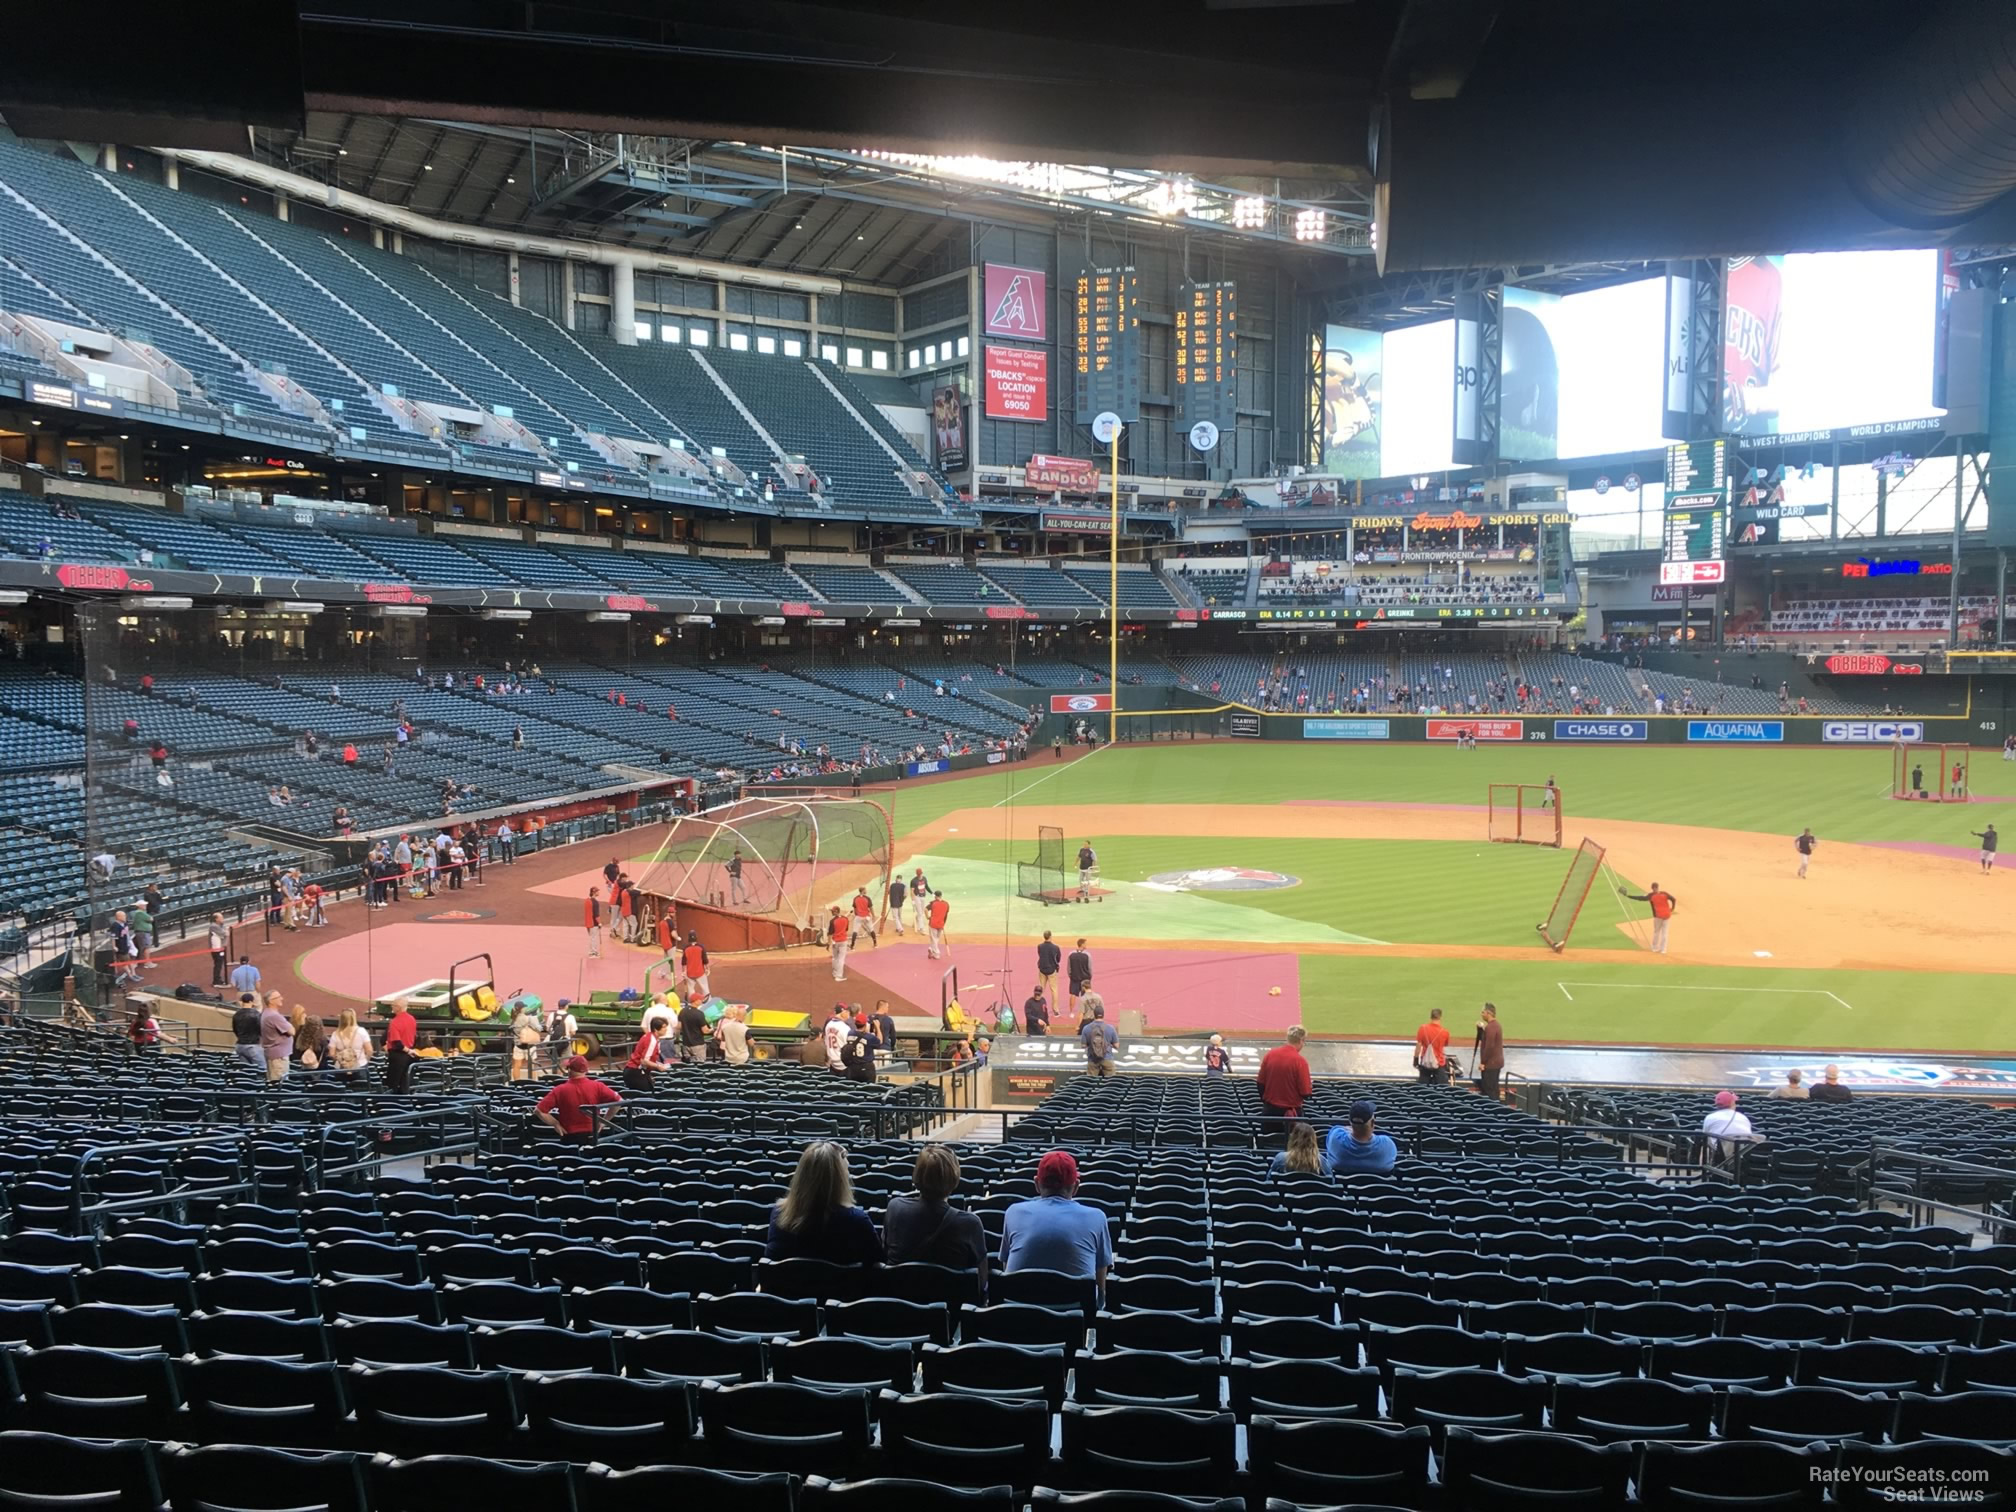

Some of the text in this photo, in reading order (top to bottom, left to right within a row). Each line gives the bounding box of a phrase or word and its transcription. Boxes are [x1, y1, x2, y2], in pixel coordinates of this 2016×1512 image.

[990, 348, 1007, 356] Report
[1024, 353, 1045, 361] Conduct
[1021, 360, 1039, 369] Texting
[998, 381, 1036, 393] LOCATION
[1004, 400, 1030, 410] 69050
[1851, 418, 1940, 437] WORLD CHAMPIONS
[1740, 430, 1830, 448] NL WEST CHAMPIONS
[267, 458, 304, 469] Audi Club
[1675, 496, 1713, 506] dbacks.com
[1757, 506, 1804, 519] WILD CARD
[1047, 520, 1098, 530] ALL-YOU-CAN-EAT
[1352, 516, 1403, 528] FRIDAY'S
[1489, 514, 1538, 525] SPORTS
[1543, 513, 1578, 524] GRILL
[1401, 551, 1487, 561] FRONTROWPHOENIX.com
[1922, 564, 1952, 575] PATIO
[1387, 609, 1415, 617] GREINKE
[1568, 724, 1618, 736] CHASE
[1704, 723, 1767, 739] AQUAFINA
[1825, 723, 1922, 741] GEICO
[1980, 722, 1996, 731] 413
[1530, 732, 1546, 740] 376
[829, 1035, 838, 1049] 12
